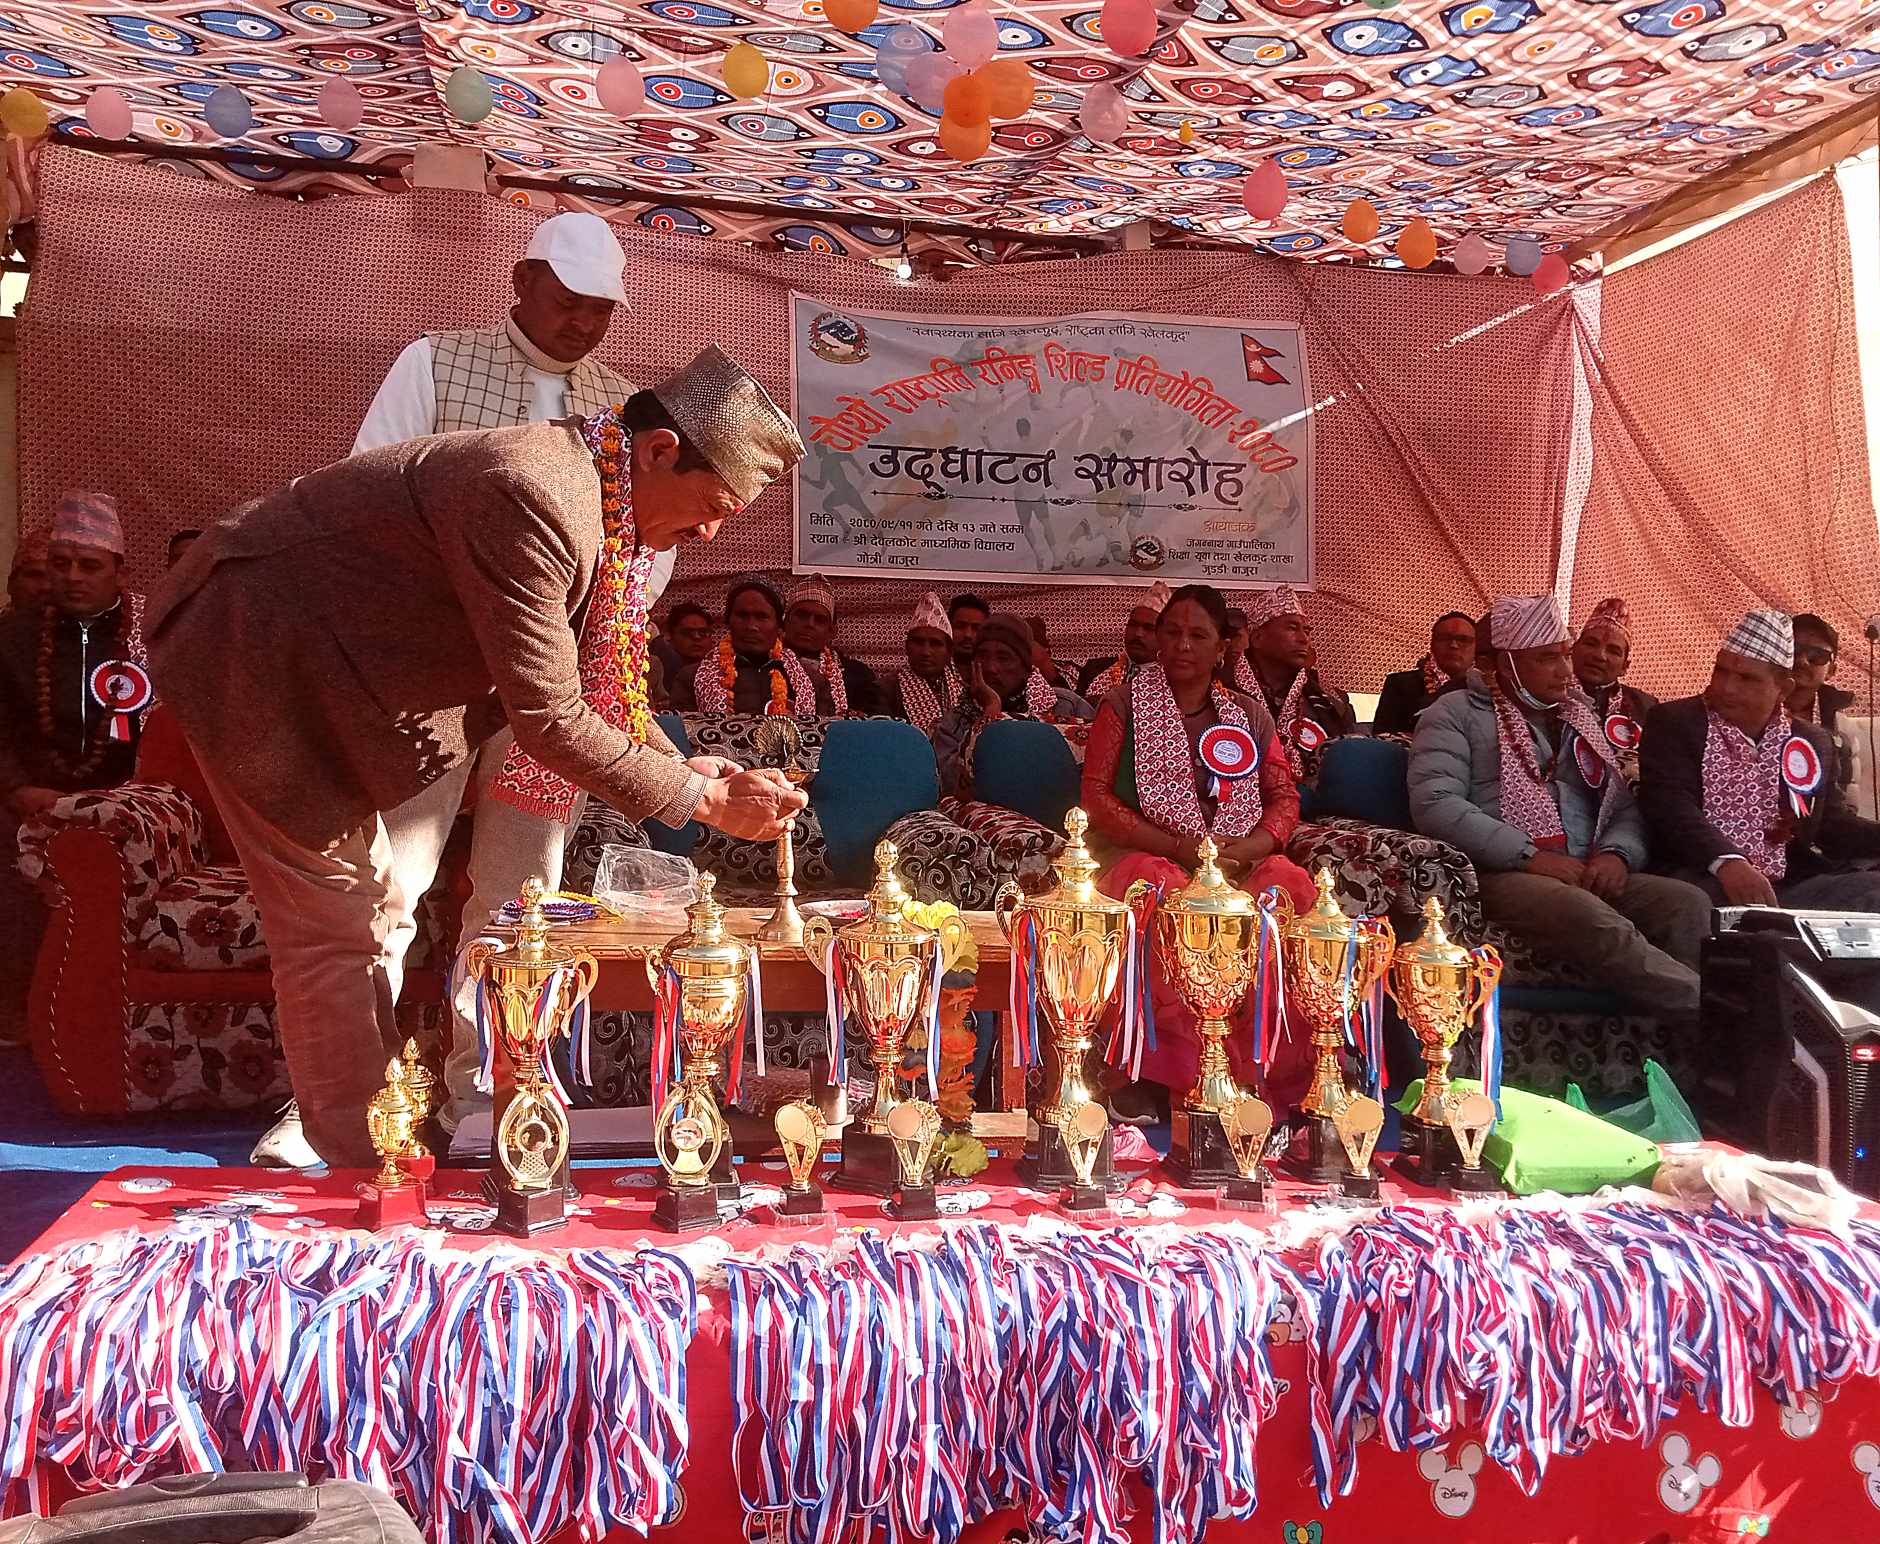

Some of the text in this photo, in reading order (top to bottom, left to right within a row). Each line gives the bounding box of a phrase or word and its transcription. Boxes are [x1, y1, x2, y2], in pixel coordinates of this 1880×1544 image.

[1109, 323, 1136, 337] लागि
[870, 356, 976, 414] राष्ट्रपति
[1044, 340, 1110, 383] शिल्ड
[1074, 446, 1247, 506] समारोह
[809, 513, 1024, 534] मिति २०८०/०९/११ गते देखि १३ गते सम्म
[808, 533, 839, 544] स्थान
[853, 534, 867, 546] श्री
[920, 537, 970, 549] माध्यमिक
[974, 538, 1015, 551] विद्यालय
[1168, 548, 1190, 560] शिक्षा
[1213, 552, 1230, 561] तथा
[1270, 554, 1294, 564] शाखा
